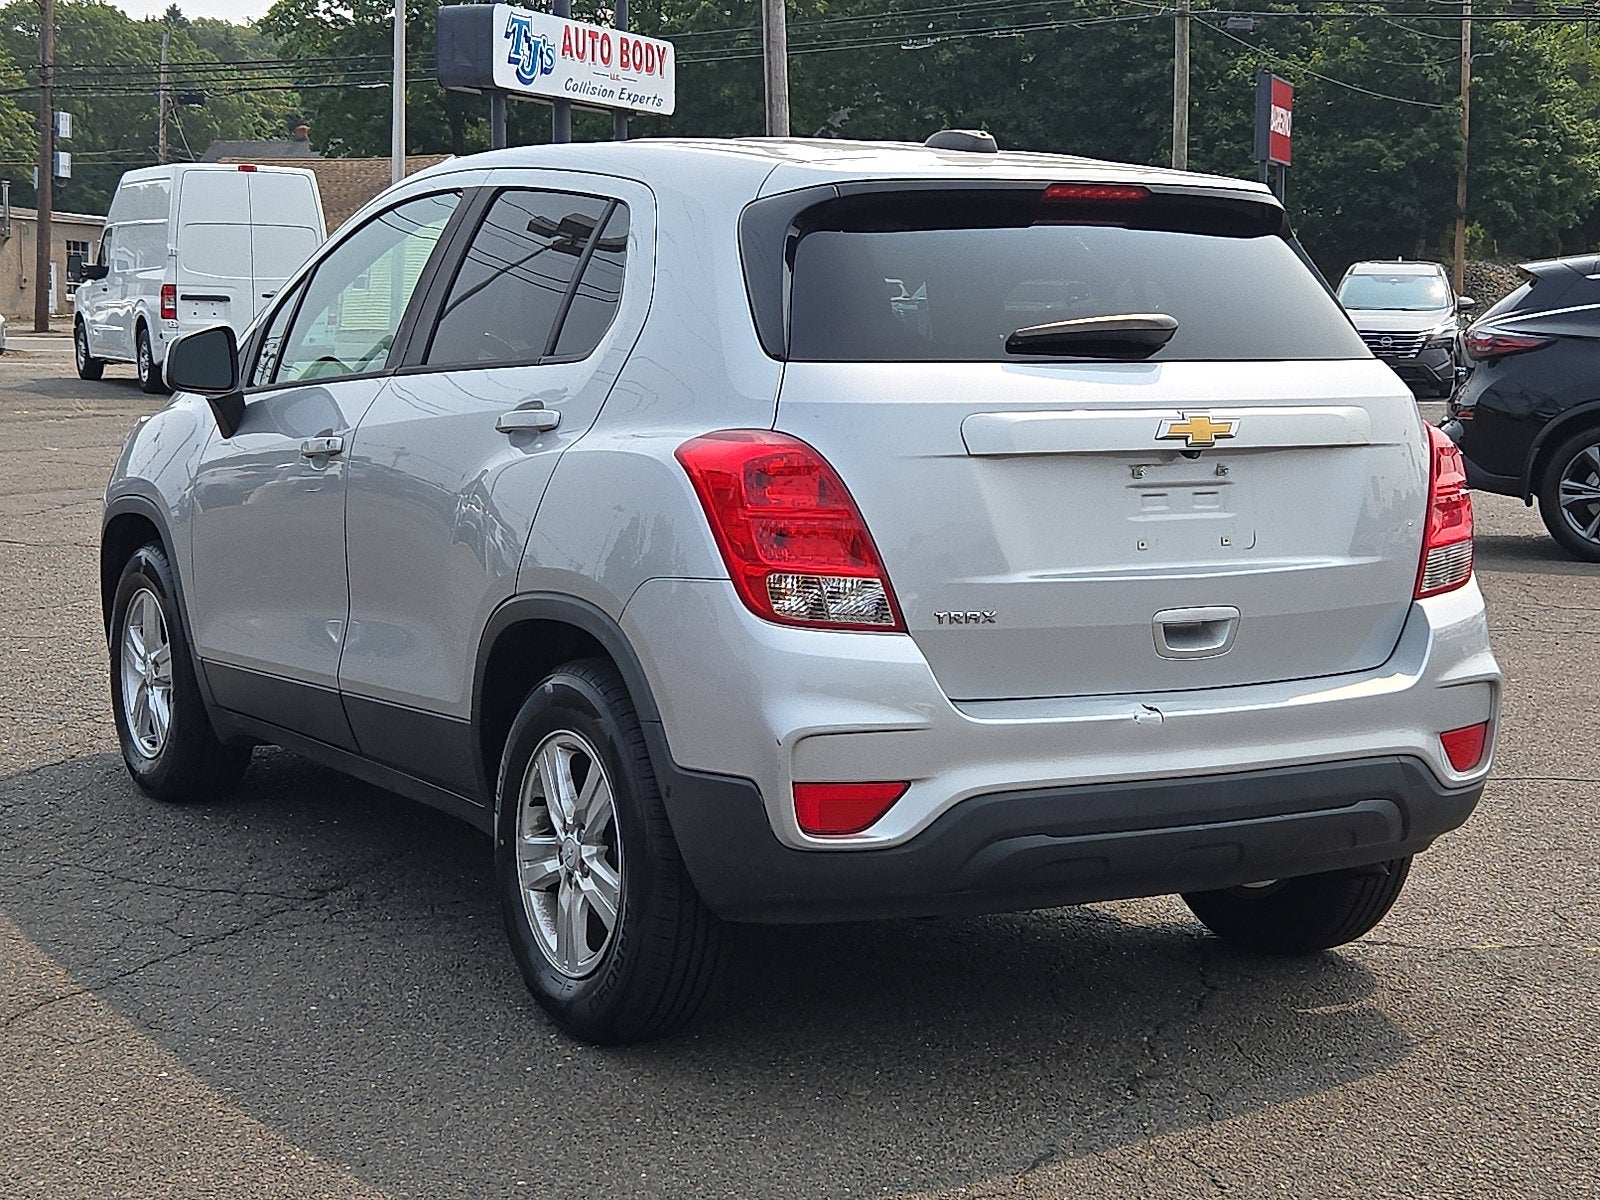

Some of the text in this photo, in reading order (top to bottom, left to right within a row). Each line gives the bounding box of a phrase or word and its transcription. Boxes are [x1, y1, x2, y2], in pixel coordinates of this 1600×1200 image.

[504, 11, 556, 86] TJ's
[561, 24, 668, 79] AUTO BODY
[564, 77, 664, 107] Collision Experts
[933, 610, 998, 625] TRAX
